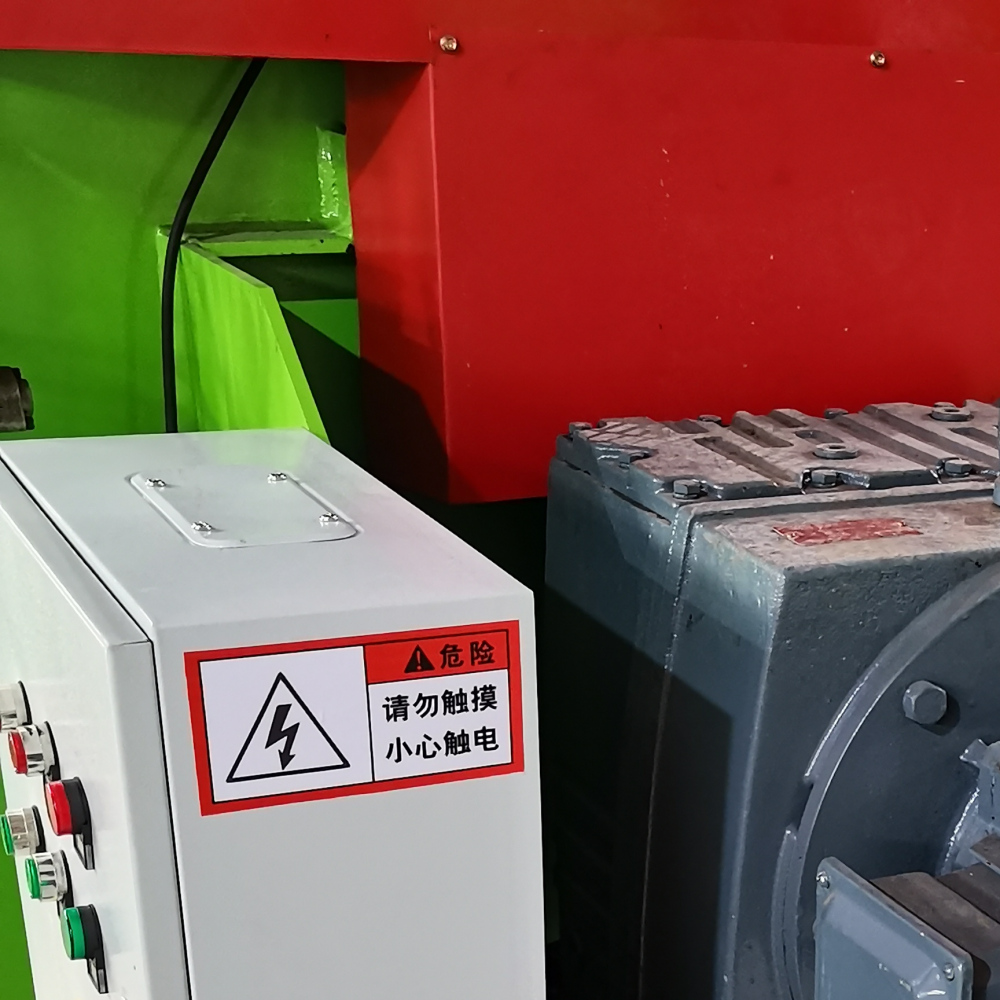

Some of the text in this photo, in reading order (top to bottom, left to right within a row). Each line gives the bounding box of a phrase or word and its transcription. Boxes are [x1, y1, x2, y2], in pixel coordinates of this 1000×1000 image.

[439, 639, 496, 669] 危险
[382, 684, 498, 723] 请勿触摸
[385, 725, 499, 763] 小心触电
